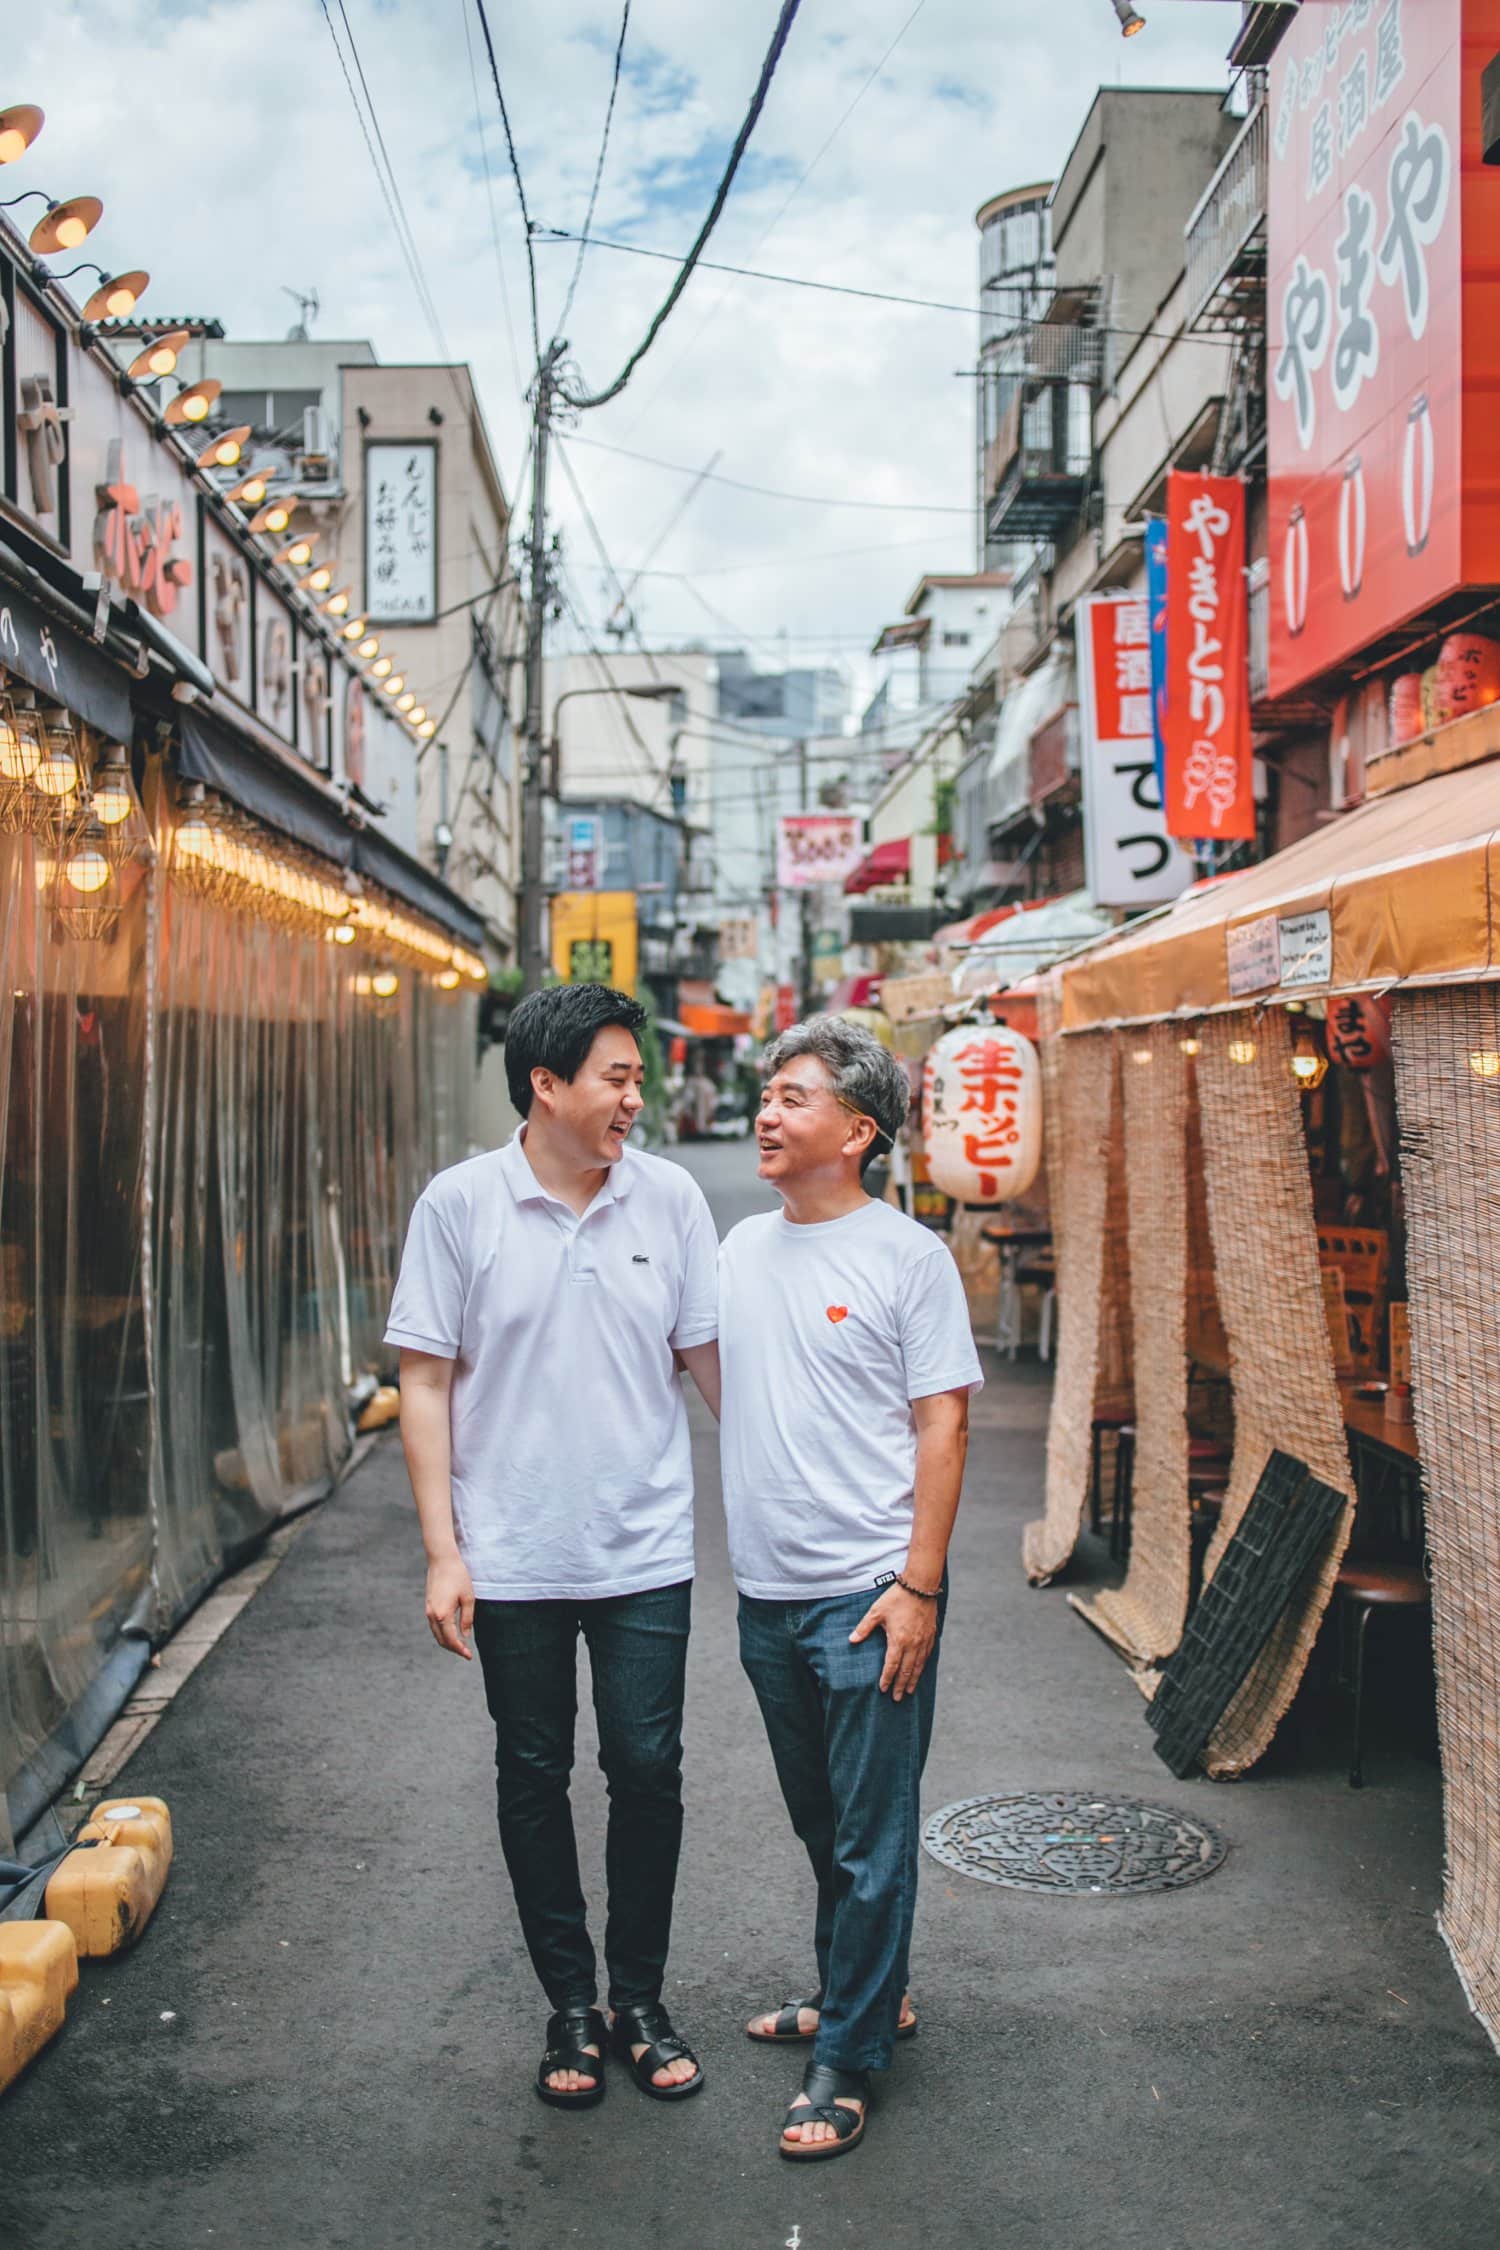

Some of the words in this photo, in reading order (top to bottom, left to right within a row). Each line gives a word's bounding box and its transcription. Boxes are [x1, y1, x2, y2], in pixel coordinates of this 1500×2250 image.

[1306, 0, 1405, 201] 居酒屋
[1275, 111, 1450, 450] やまや
[1113, 604, 1153, 736] 居酒屋
[1182, 494, 1231, 737] やきとり
[1113, 761, 1170, 880] てつ
[953, 1039, 1023, 1197] 生ホッピー
